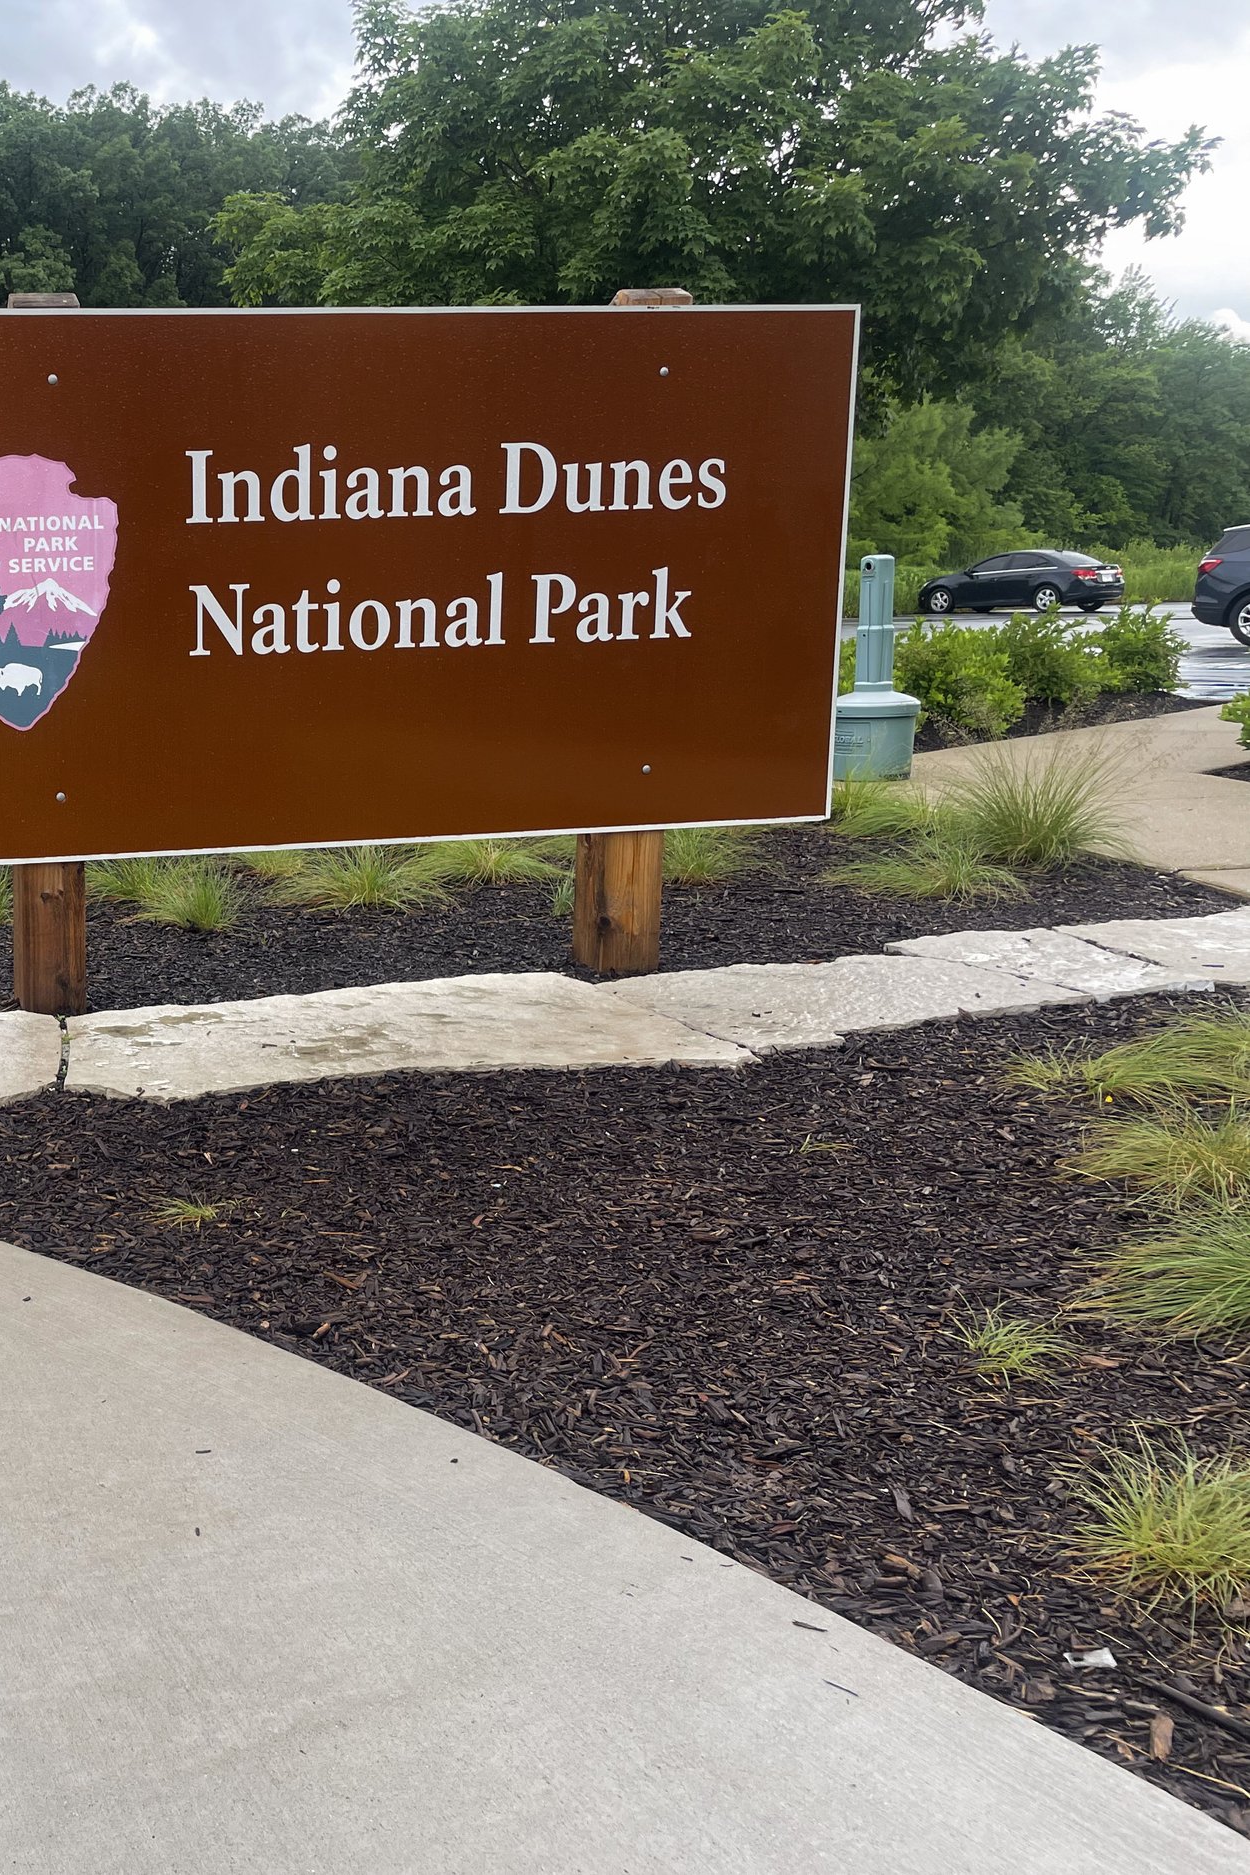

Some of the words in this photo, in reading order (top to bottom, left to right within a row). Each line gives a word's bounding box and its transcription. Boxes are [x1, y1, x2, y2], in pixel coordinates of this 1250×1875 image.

[185, 444, 477, 524] Indiana
[498, 442, 727, 514] Dunes
[8, 556, 95, 574] SERVICE
[23, 536, 79, 553] PARK
[188, 571, 506, 657] National
[528, 566, 692, 644] Park
